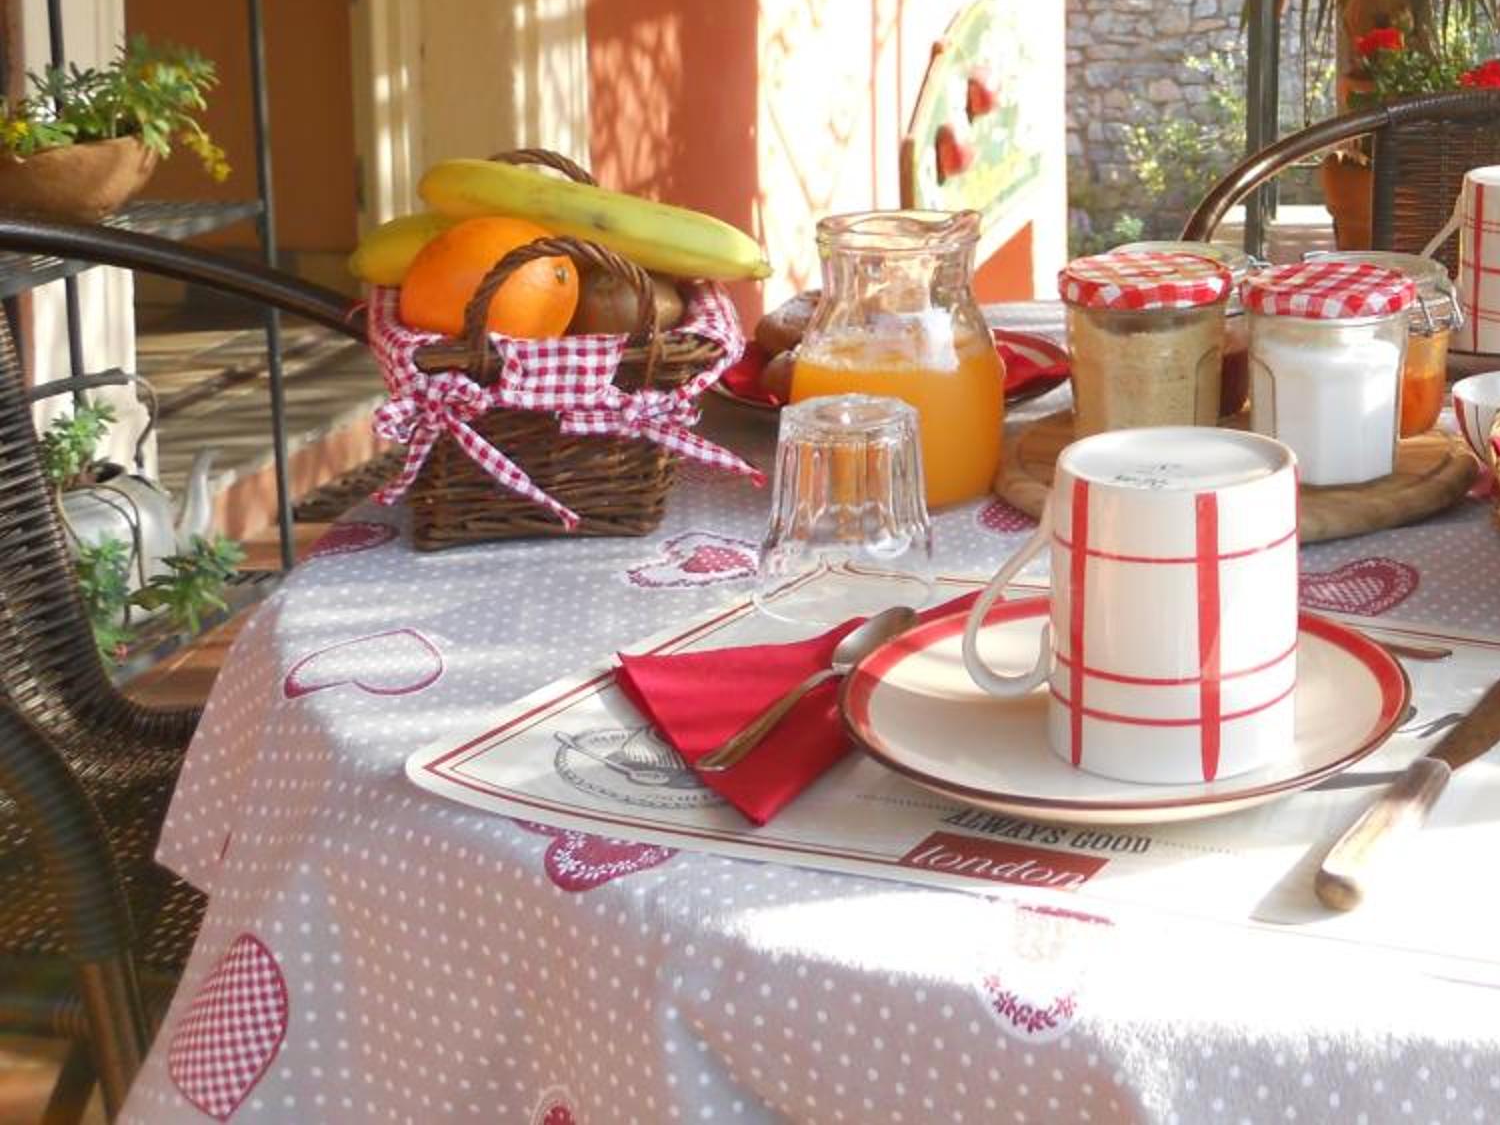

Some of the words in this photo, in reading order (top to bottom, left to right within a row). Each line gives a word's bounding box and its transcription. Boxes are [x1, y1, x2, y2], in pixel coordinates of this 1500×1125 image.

[942, 808, 1067, 845] ALWAYS
[1069, 831, 1153, 854] GOOD
[911, 843, 1087, 890] london
